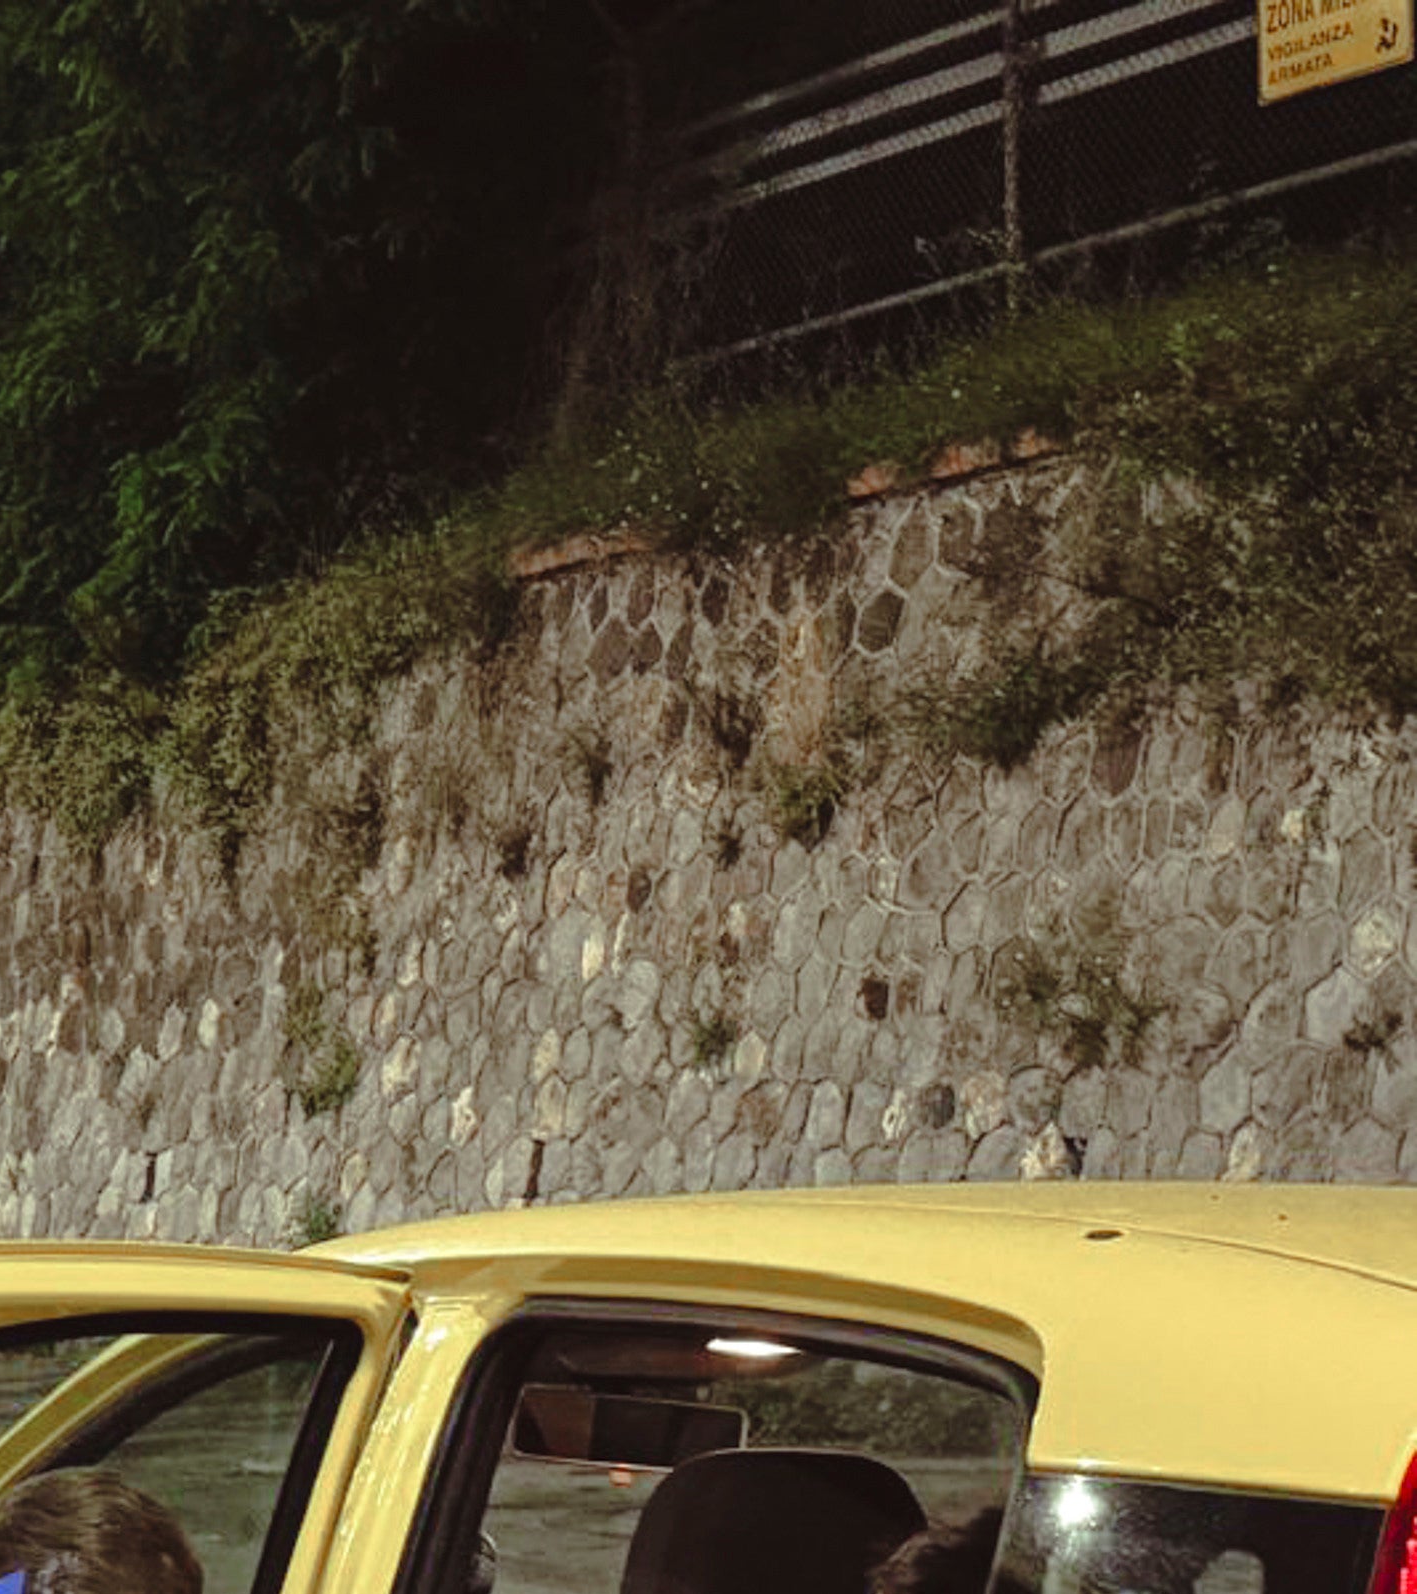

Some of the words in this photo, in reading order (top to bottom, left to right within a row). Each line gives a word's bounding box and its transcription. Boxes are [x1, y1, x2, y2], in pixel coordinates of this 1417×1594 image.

[1267, 0, 1314, 34] ZONA
[1267, 21, 1354, 61] VIGILANZA
[1267, 53, 1334, 86] ARMATA
